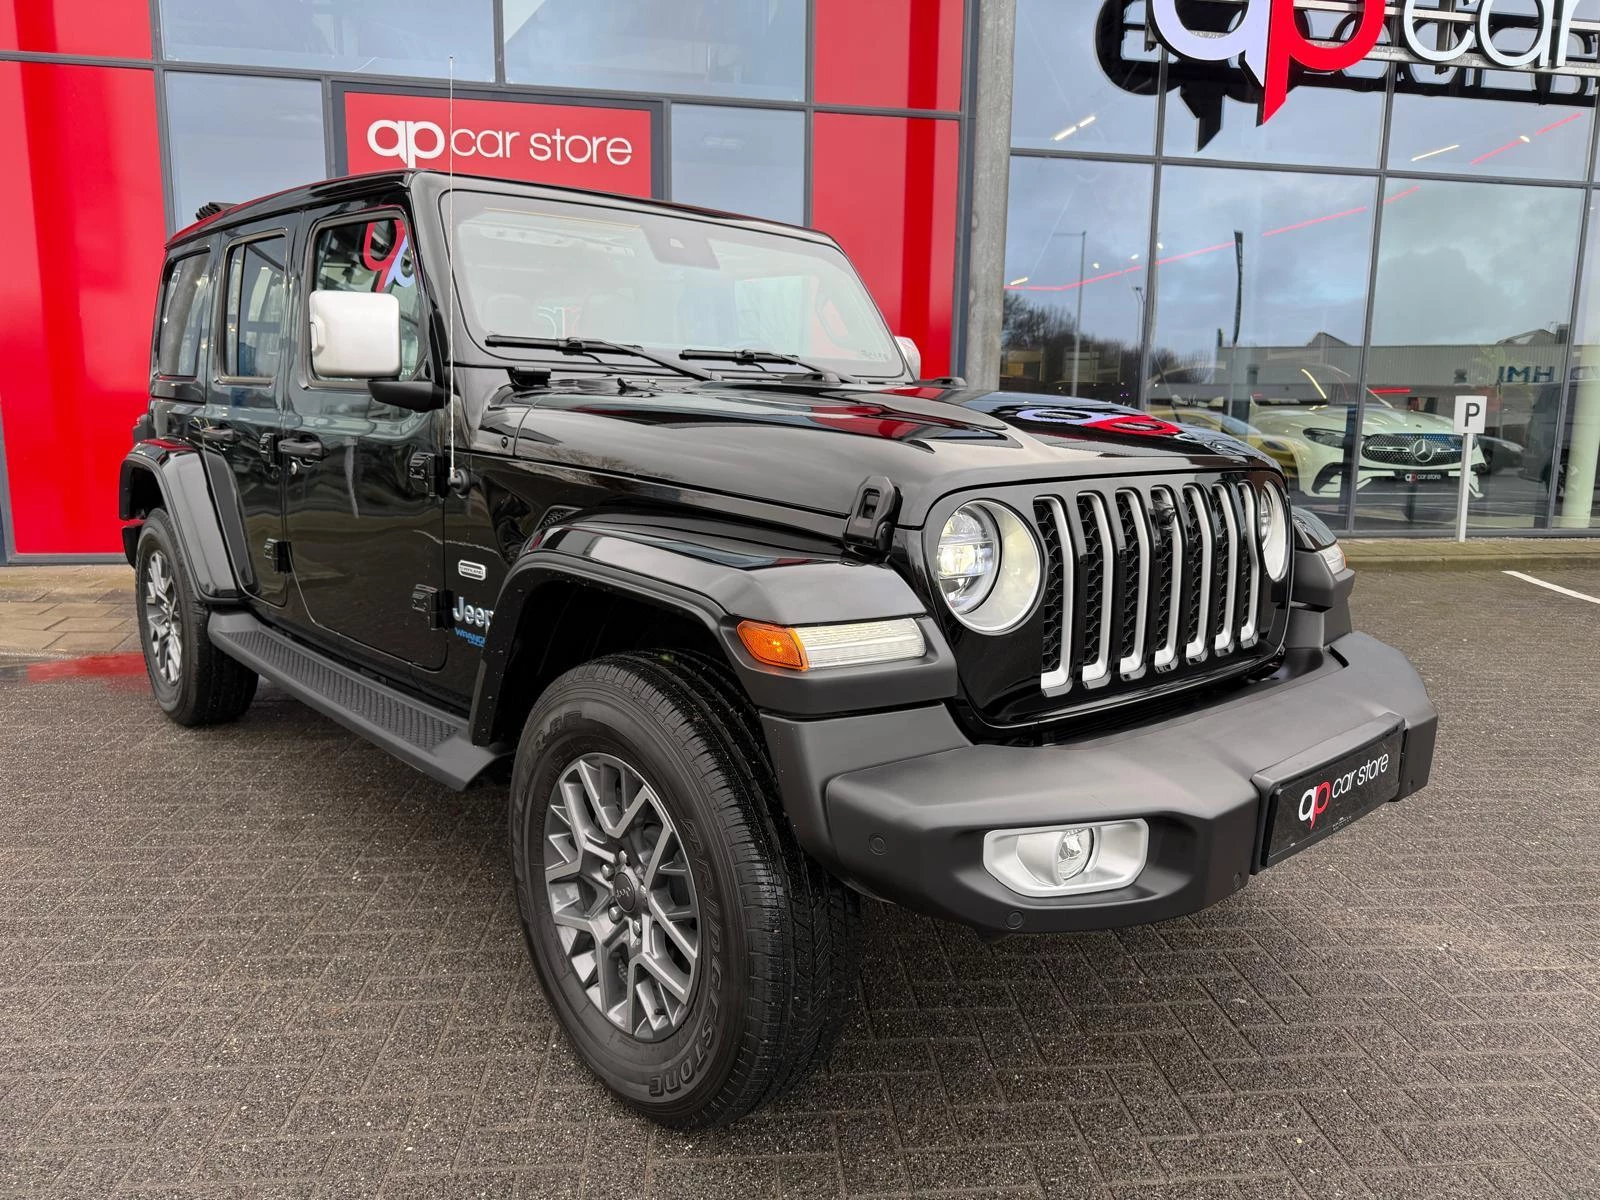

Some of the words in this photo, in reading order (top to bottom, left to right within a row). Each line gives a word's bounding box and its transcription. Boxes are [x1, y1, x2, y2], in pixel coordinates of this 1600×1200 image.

[1404, 0, 1584, 68] car
[451, 128, 520, 159] car
[529, 128, 632, 166] store
[1464, 402, 1480, 427] P
[1332, 769, 1357, 799] car
[1357, 753, 1389, 786] store
